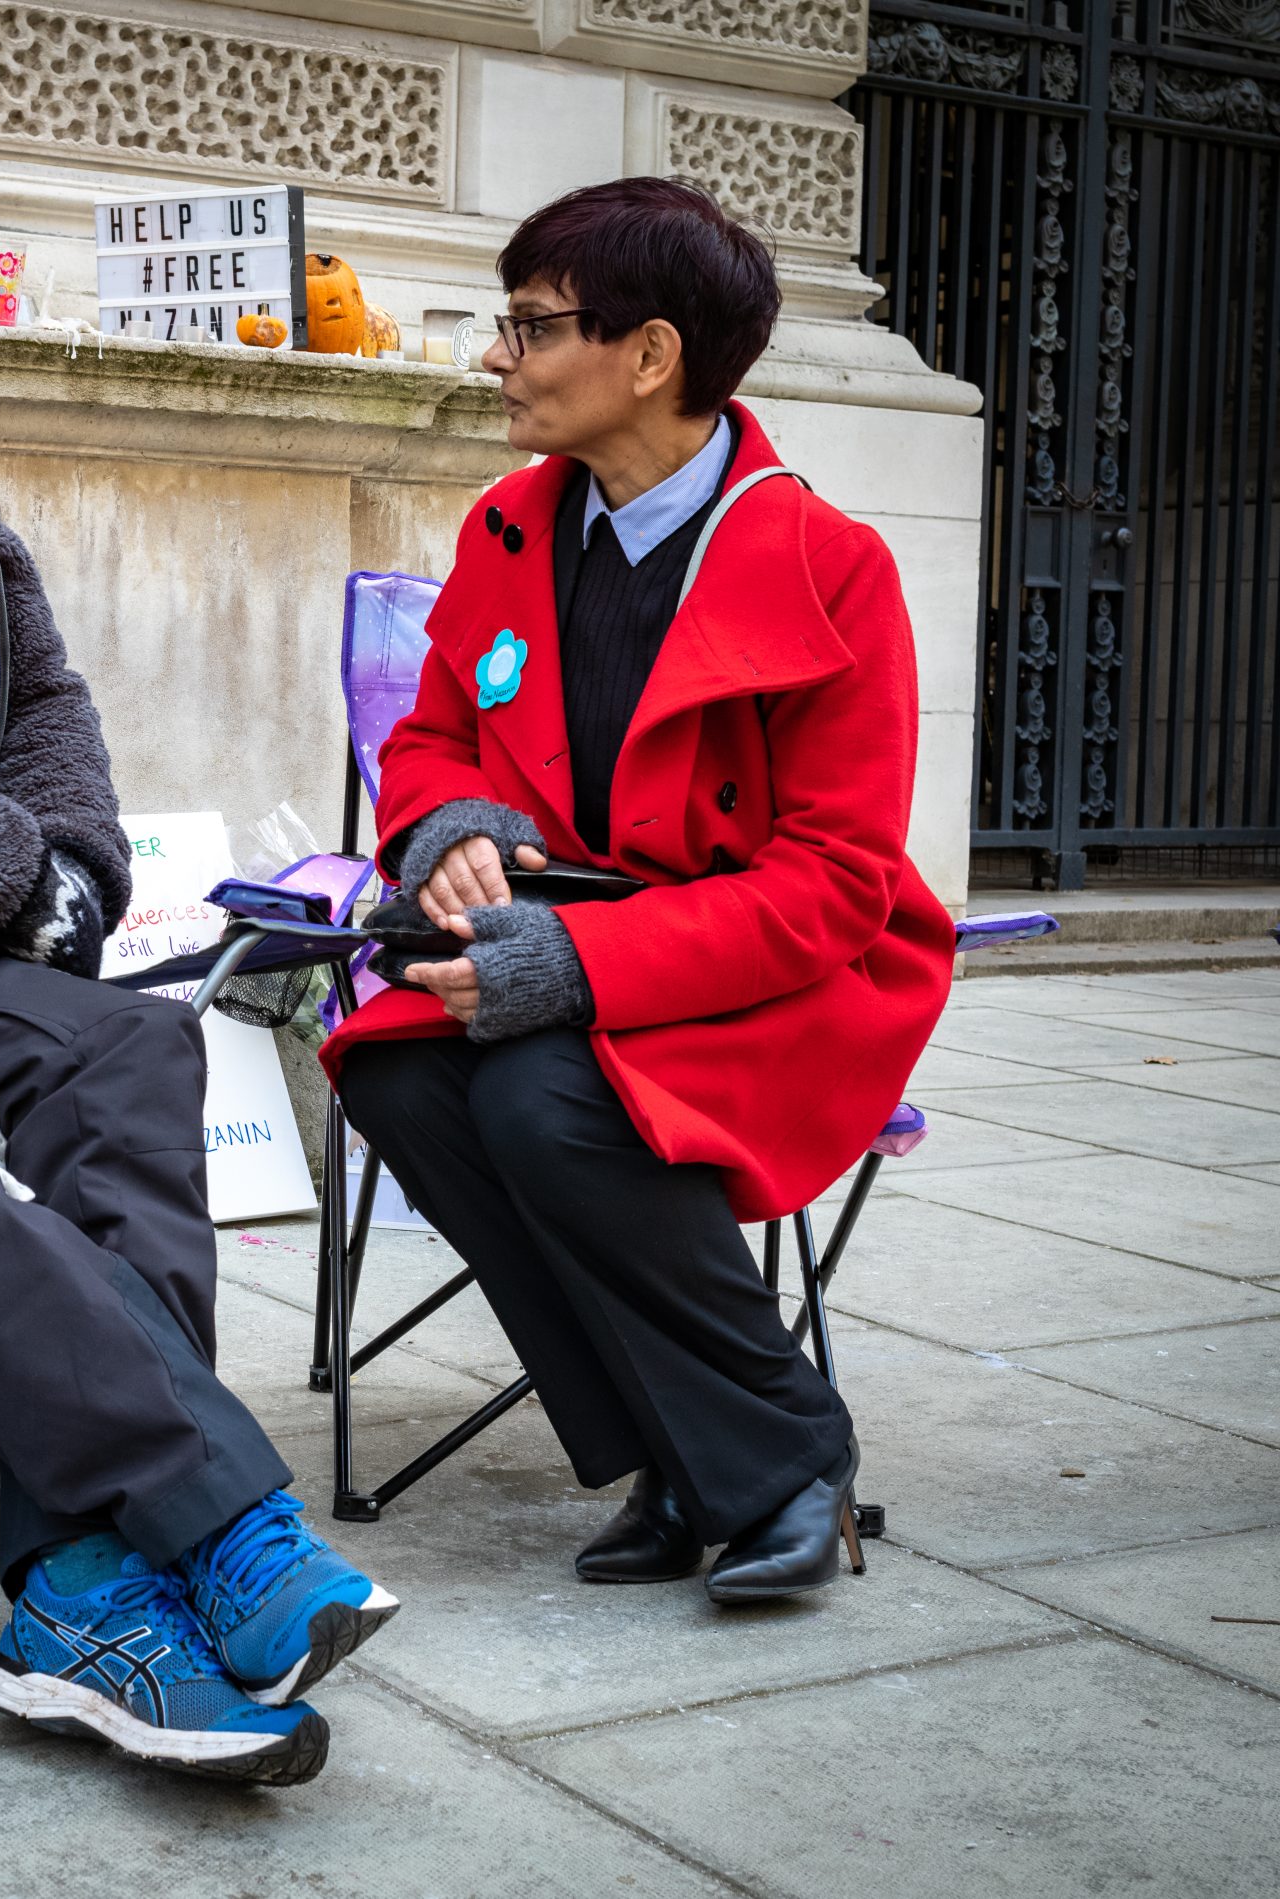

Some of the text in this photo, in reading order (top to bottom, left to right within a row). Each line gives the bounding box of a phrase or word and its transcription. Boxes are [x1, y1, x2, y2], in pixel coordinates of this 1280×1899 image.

[111, 198, 267, 242] HELP US
[143, 251, 245, 293] #FREE
[203, 1120, 271, 1152] ZANIN
